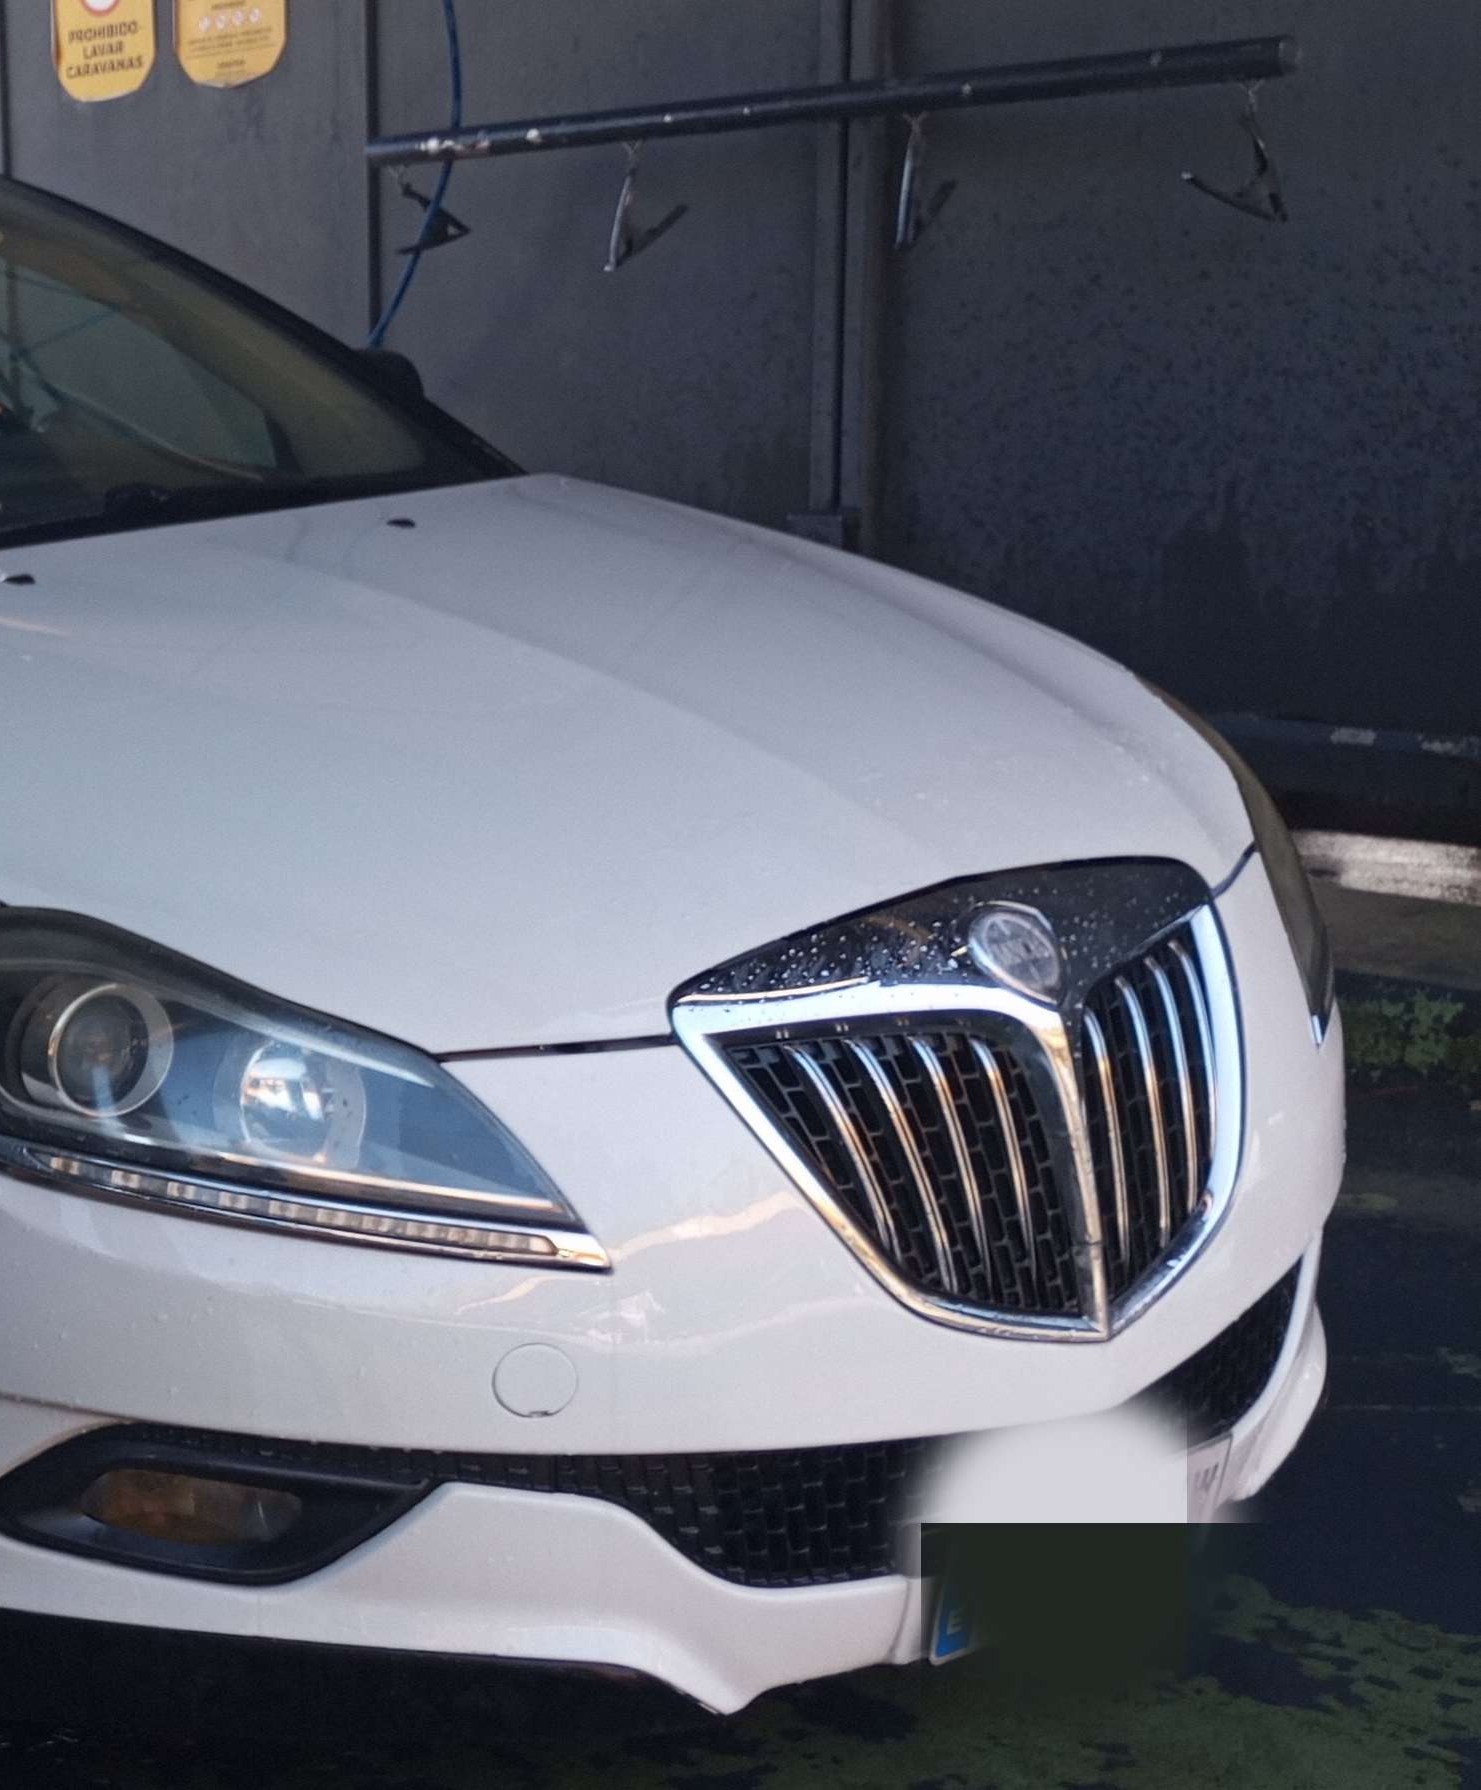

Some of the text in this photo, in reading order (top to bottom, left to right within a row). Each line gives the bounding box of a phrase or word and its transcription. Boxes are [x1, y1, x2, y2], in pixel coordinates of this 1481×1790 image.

[68, 20, 137, 42] PROHIBIDO
[83, 40, 123, 59] LAVAR
[66, 55, 142, 78] CARAVANAS
